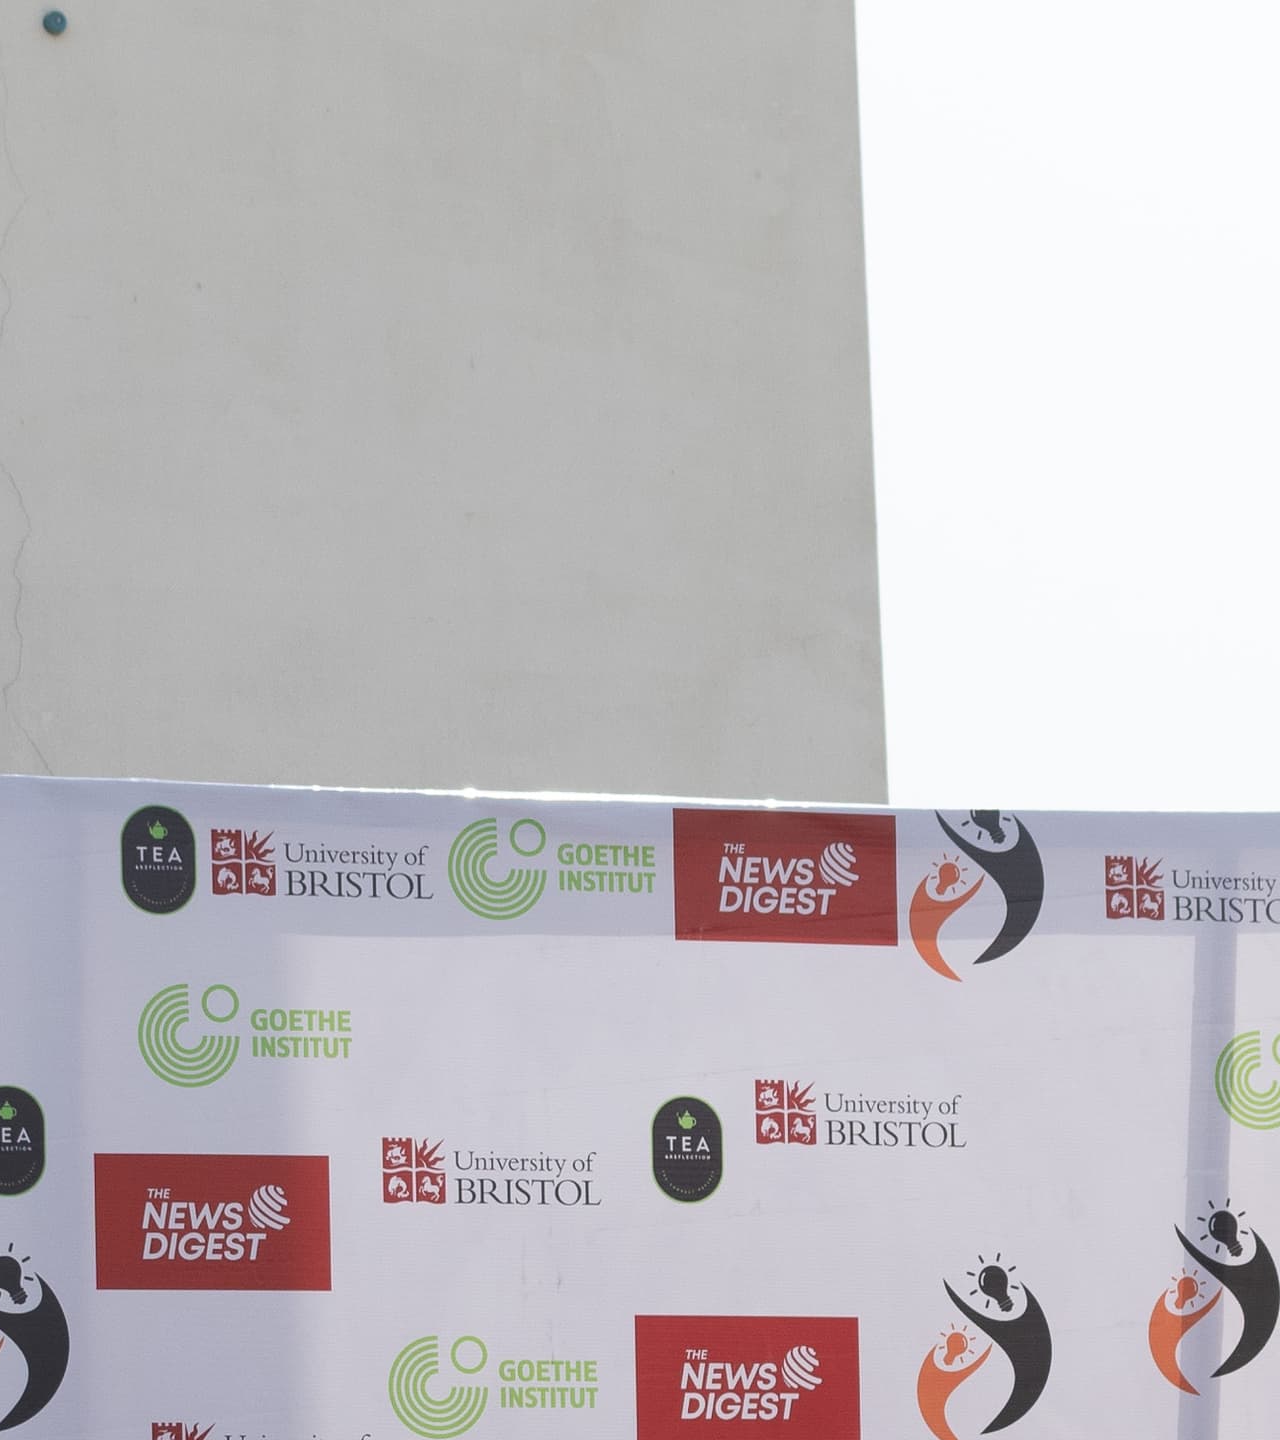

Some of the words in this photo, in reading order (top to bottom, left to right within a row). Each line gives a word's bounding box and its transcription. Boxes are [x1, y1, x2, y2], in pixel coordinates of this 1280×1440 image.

[136, 846, 181, 863] TEA
[285, 843, 397, 871] University
[405, 846, 429, 865] of
[557, 843, 655, 867] GOETHE
[724, 844, 744, 853] THE
[559, 870, 656, 893] INSTITUT
[719, 857, 814, 885] NEWS
[1173, 870, 1276, 893] University
[285, 871, 433, 899] BRISTOL
[720, 886, 836, 914] DIGEST
[825, 1093, 932, 1117] University
[939, 1095, 961, 1114] of
[666, 1136, 709, 1152] TEA
[826, 1116, 966, 1147] BRISTOL
[455, 1151, 566, 1177] University
[573, 1152, 596, 1172] of
[148, 1189, 170, 1198] THE
[455, 1178, 600, 1205] BRISTOL
[143, 1200, 243, 1230] NEWS
[143, 1232, 266, 1260] DIGEST
[686, 1350, 707, 1360] THE
[499, 1360, 597, 1382] GOETHE
[681, 1362, 777, 1390] NEWS
[500, 1387, 598, 1408] INSTITUT
[682, 1393, 799, 1420] DIGEST
